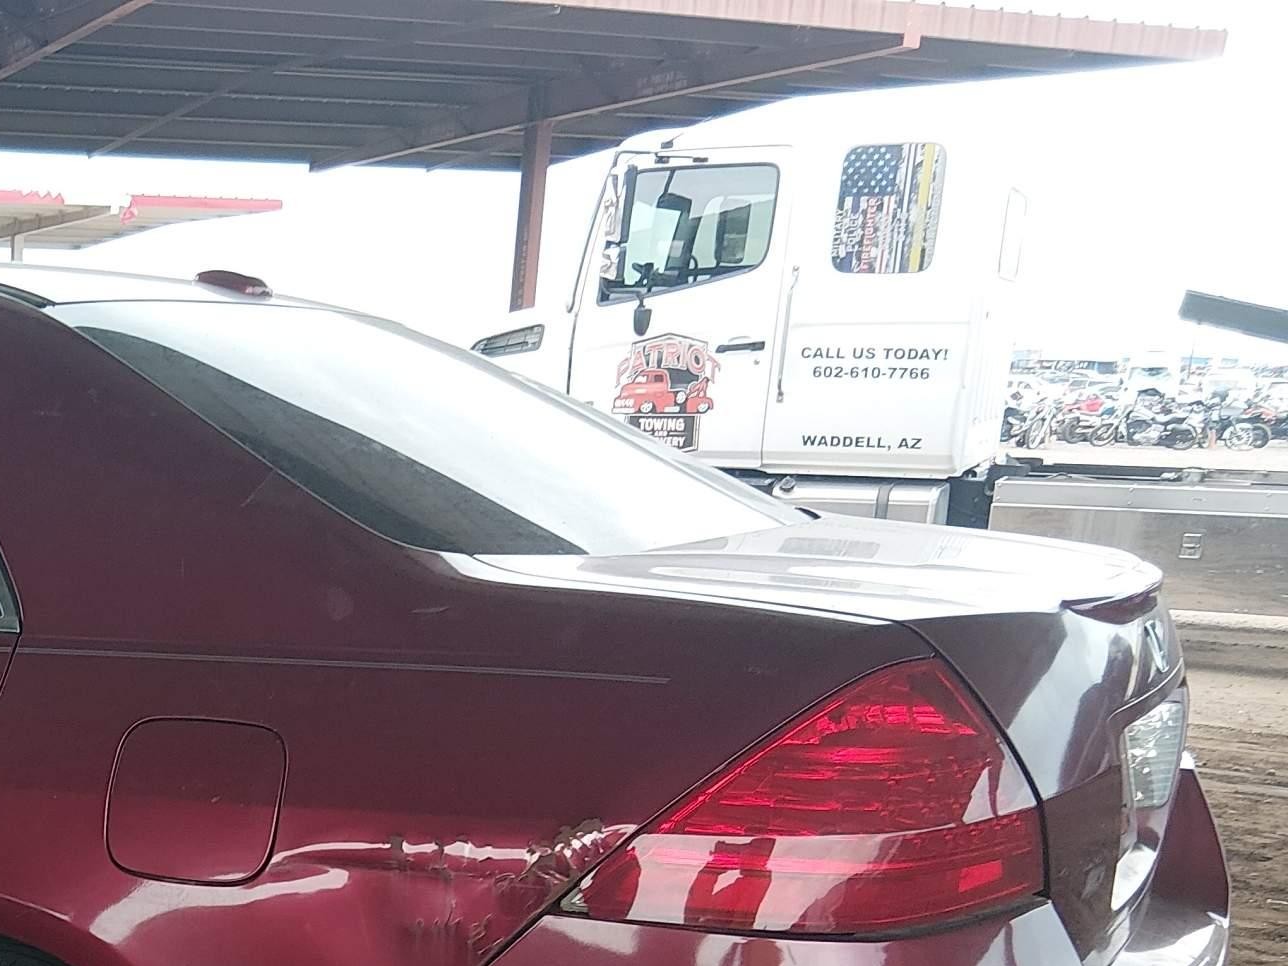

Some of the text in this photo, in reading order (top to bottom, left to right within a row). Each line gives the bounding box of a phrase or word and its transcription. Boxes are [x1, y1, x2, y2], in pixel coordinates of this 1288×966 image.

[802, 347, 948, 360] CALL US TODAY!
[616, 340, 720, 385] PATRIOT
[813, 367, 929, 379] 602-610-7766
[638, 418, 685, 431] TOWING
[802, 435, 922, 451] WADDELL, AZ
